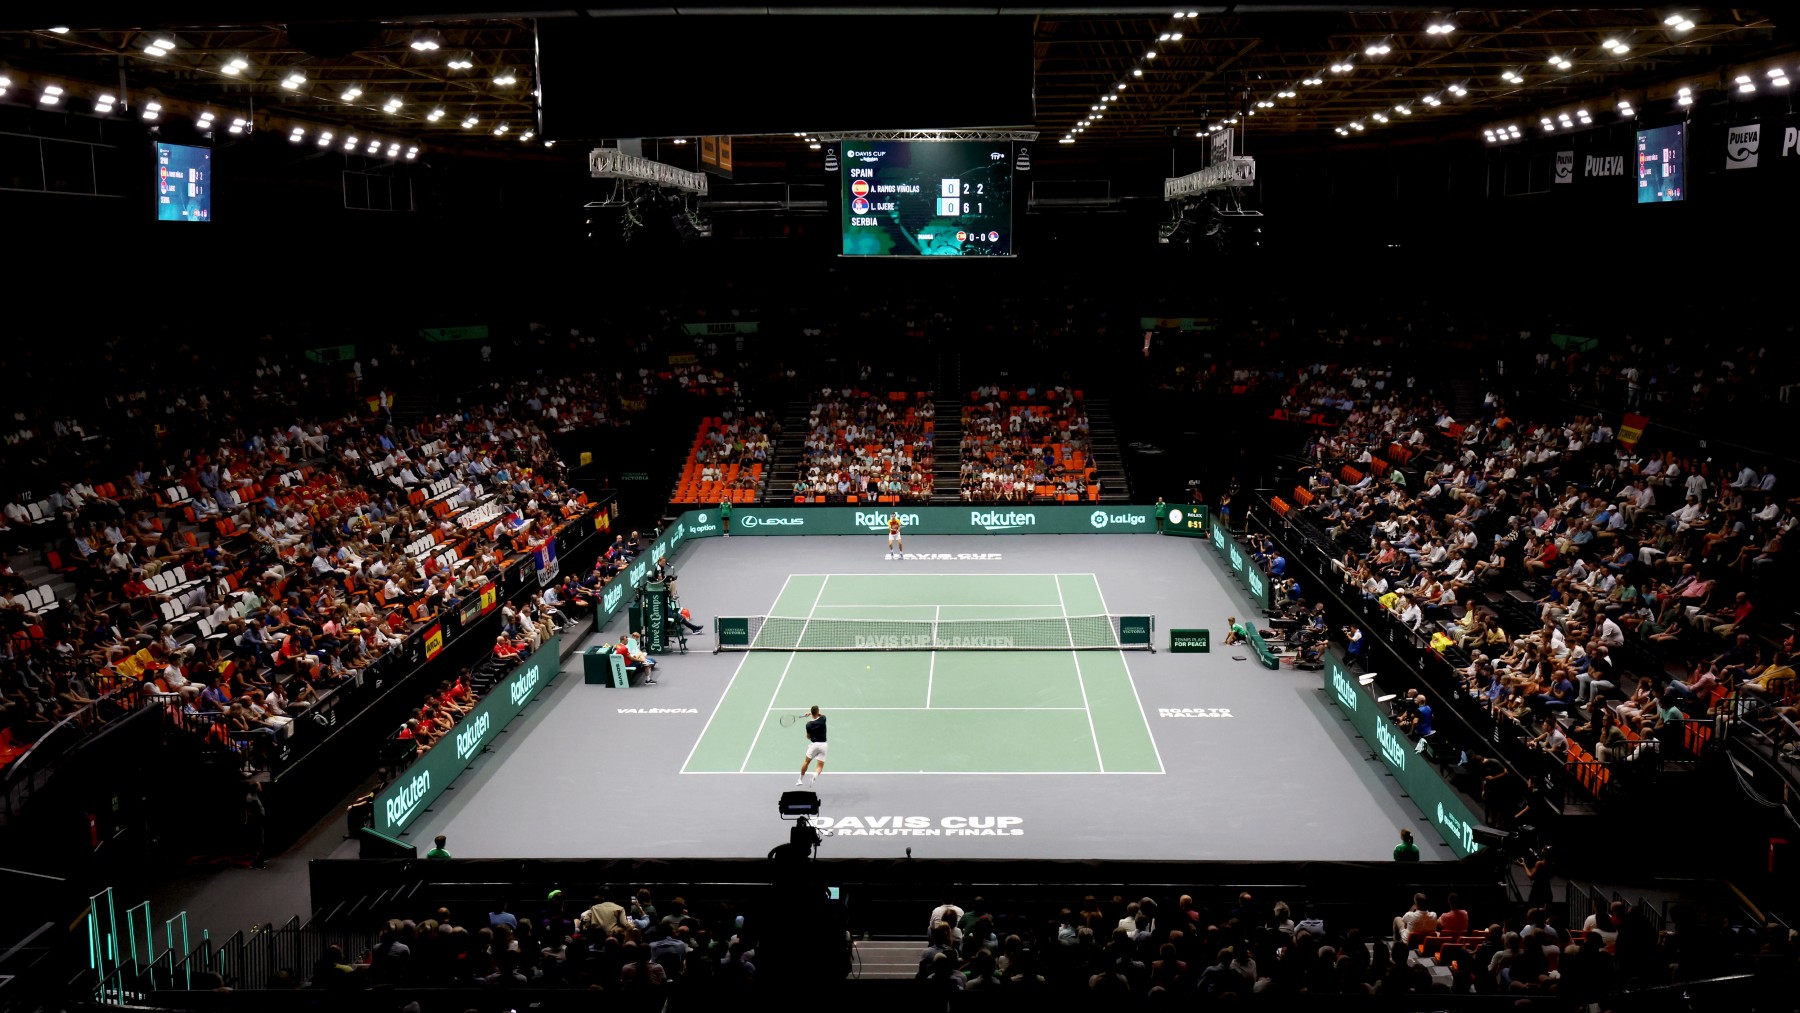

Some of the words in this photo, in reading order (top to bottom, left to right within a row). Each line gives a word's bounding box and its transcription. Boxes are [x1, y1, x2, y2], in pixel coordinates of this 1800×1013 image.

[1730, 131, 1758, 144] PULEVA
[1556, 155, 1573, 165] PULEVA
[1584, 154, 1624, 177] PULEVA
[850, 168, 873, 178] SPAIN
[871, 185, 876, 193] A.
[877, 185, 895, 193] RAMOS
[897, 183, 920, 193] VIÑOLAS
[948, 184, 954, 194] 0
[963, 183, 970, 195] 2
[977, 183, 984, 195] 2
[871, 203, 876, 211] L.
[877, 203, 895, 211] DJERE
[948, 203, 954, 213] 0
[963, 202, 970, 214] 6
[978, 202, 983, 214] 1
[851, 217, 878, 226] SERBIA
[20, 490, 32, 502] 112
[855, 511, 919, 531] Rakuten
[971, 511, 1035, 531] Rakuten
[1110, 514, 1146, 526] LaLiga
[689, 525, 696, 533] iq
[696, 523, 716, 532] option
[1248, 566, 1263, 598] Rakuten
[604, 583, 623, 614] Rakuten
[649, 594, 662, 621] Camps
[651, 621, 661, 629] &
[651, 628, 662, 652] Juvé
[855, 635, 900, 647] DAVIS
[901, 635, 931, 647] CUP
[953, 636, 1014, 647] RAKUTEN
[511, 664, 540, 706] Rakuten
[1333, 665, 1357, 711] Rakuten
[457, 711, 490, 760] Rakuten
[1376, 716, 1405, 771] Rakuten
[386, 769, 431, 828] Rakuten
[808, 816, 930, 828] DAVIS
[940, 816, 1024, 828] CUP
[837, 828, 941, 836] RAKUTEN
[944, 828, 1025, 836] FINALS
